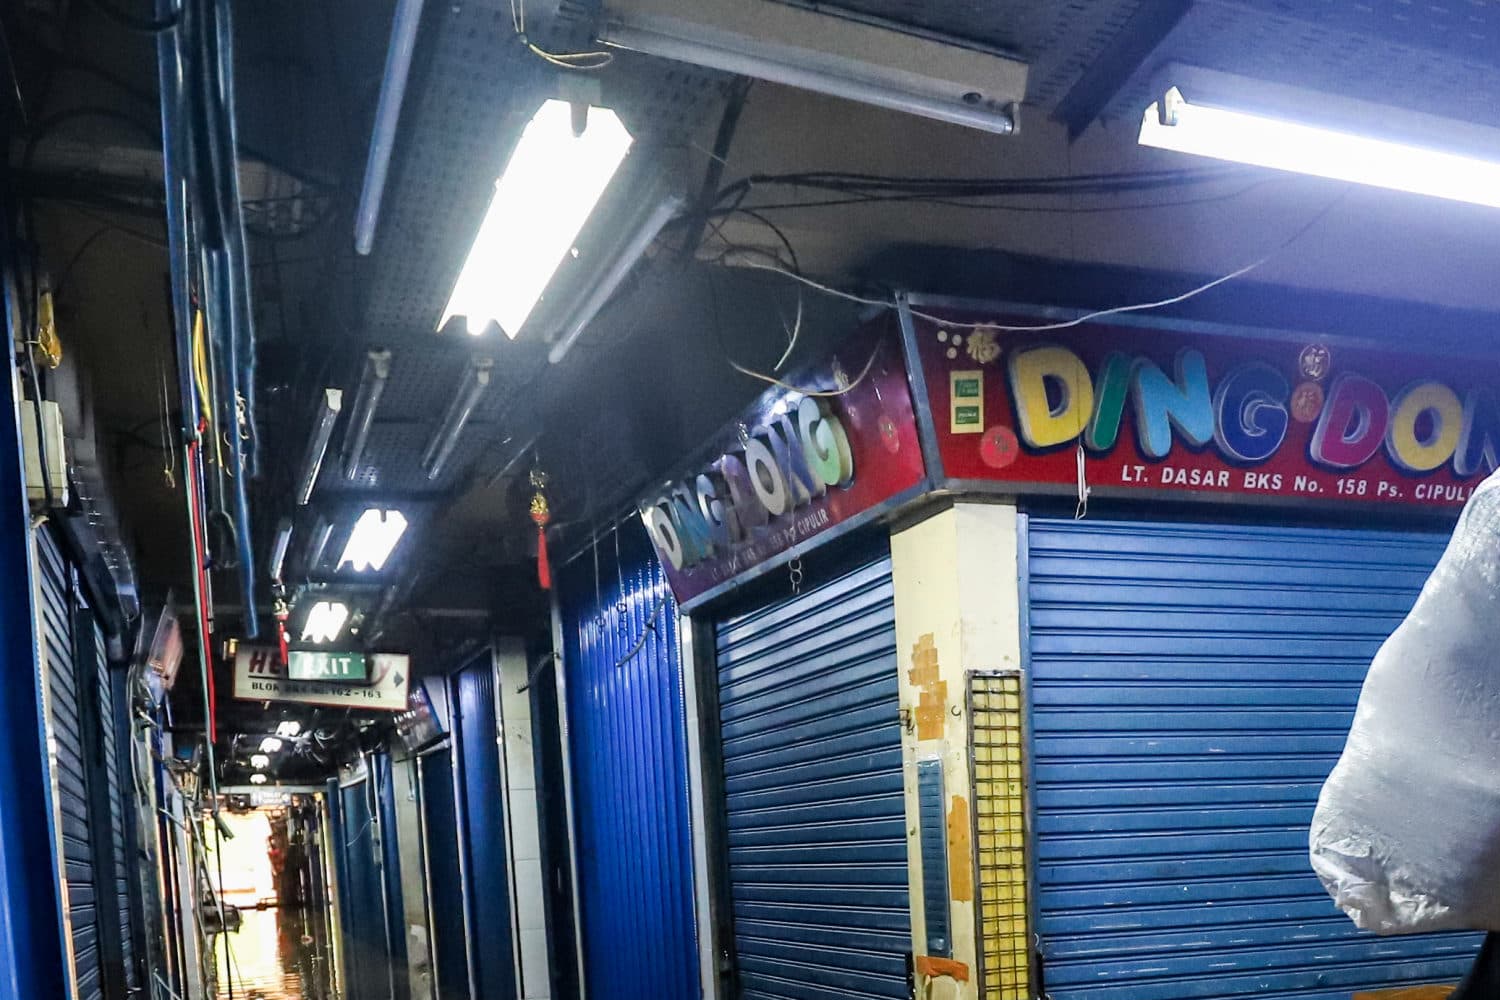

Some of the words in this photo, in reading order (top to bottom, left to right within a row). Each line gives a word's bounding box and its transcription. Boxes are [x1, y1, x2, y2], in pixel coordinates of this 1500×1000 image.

[1008, 345, 1289, 463] DING
[1121, 465, 1149, 483] LT.
[1161, 467, 1230, 487] DASAR
[1243, 472, 1283, 490] BKS
[1294, 475, 1324, 493] No.
[1336, 478, 1367, 496] 158
[1377, 480, 1403, 499] Ps.
[797, 507, 829, 535] CIPULIR
